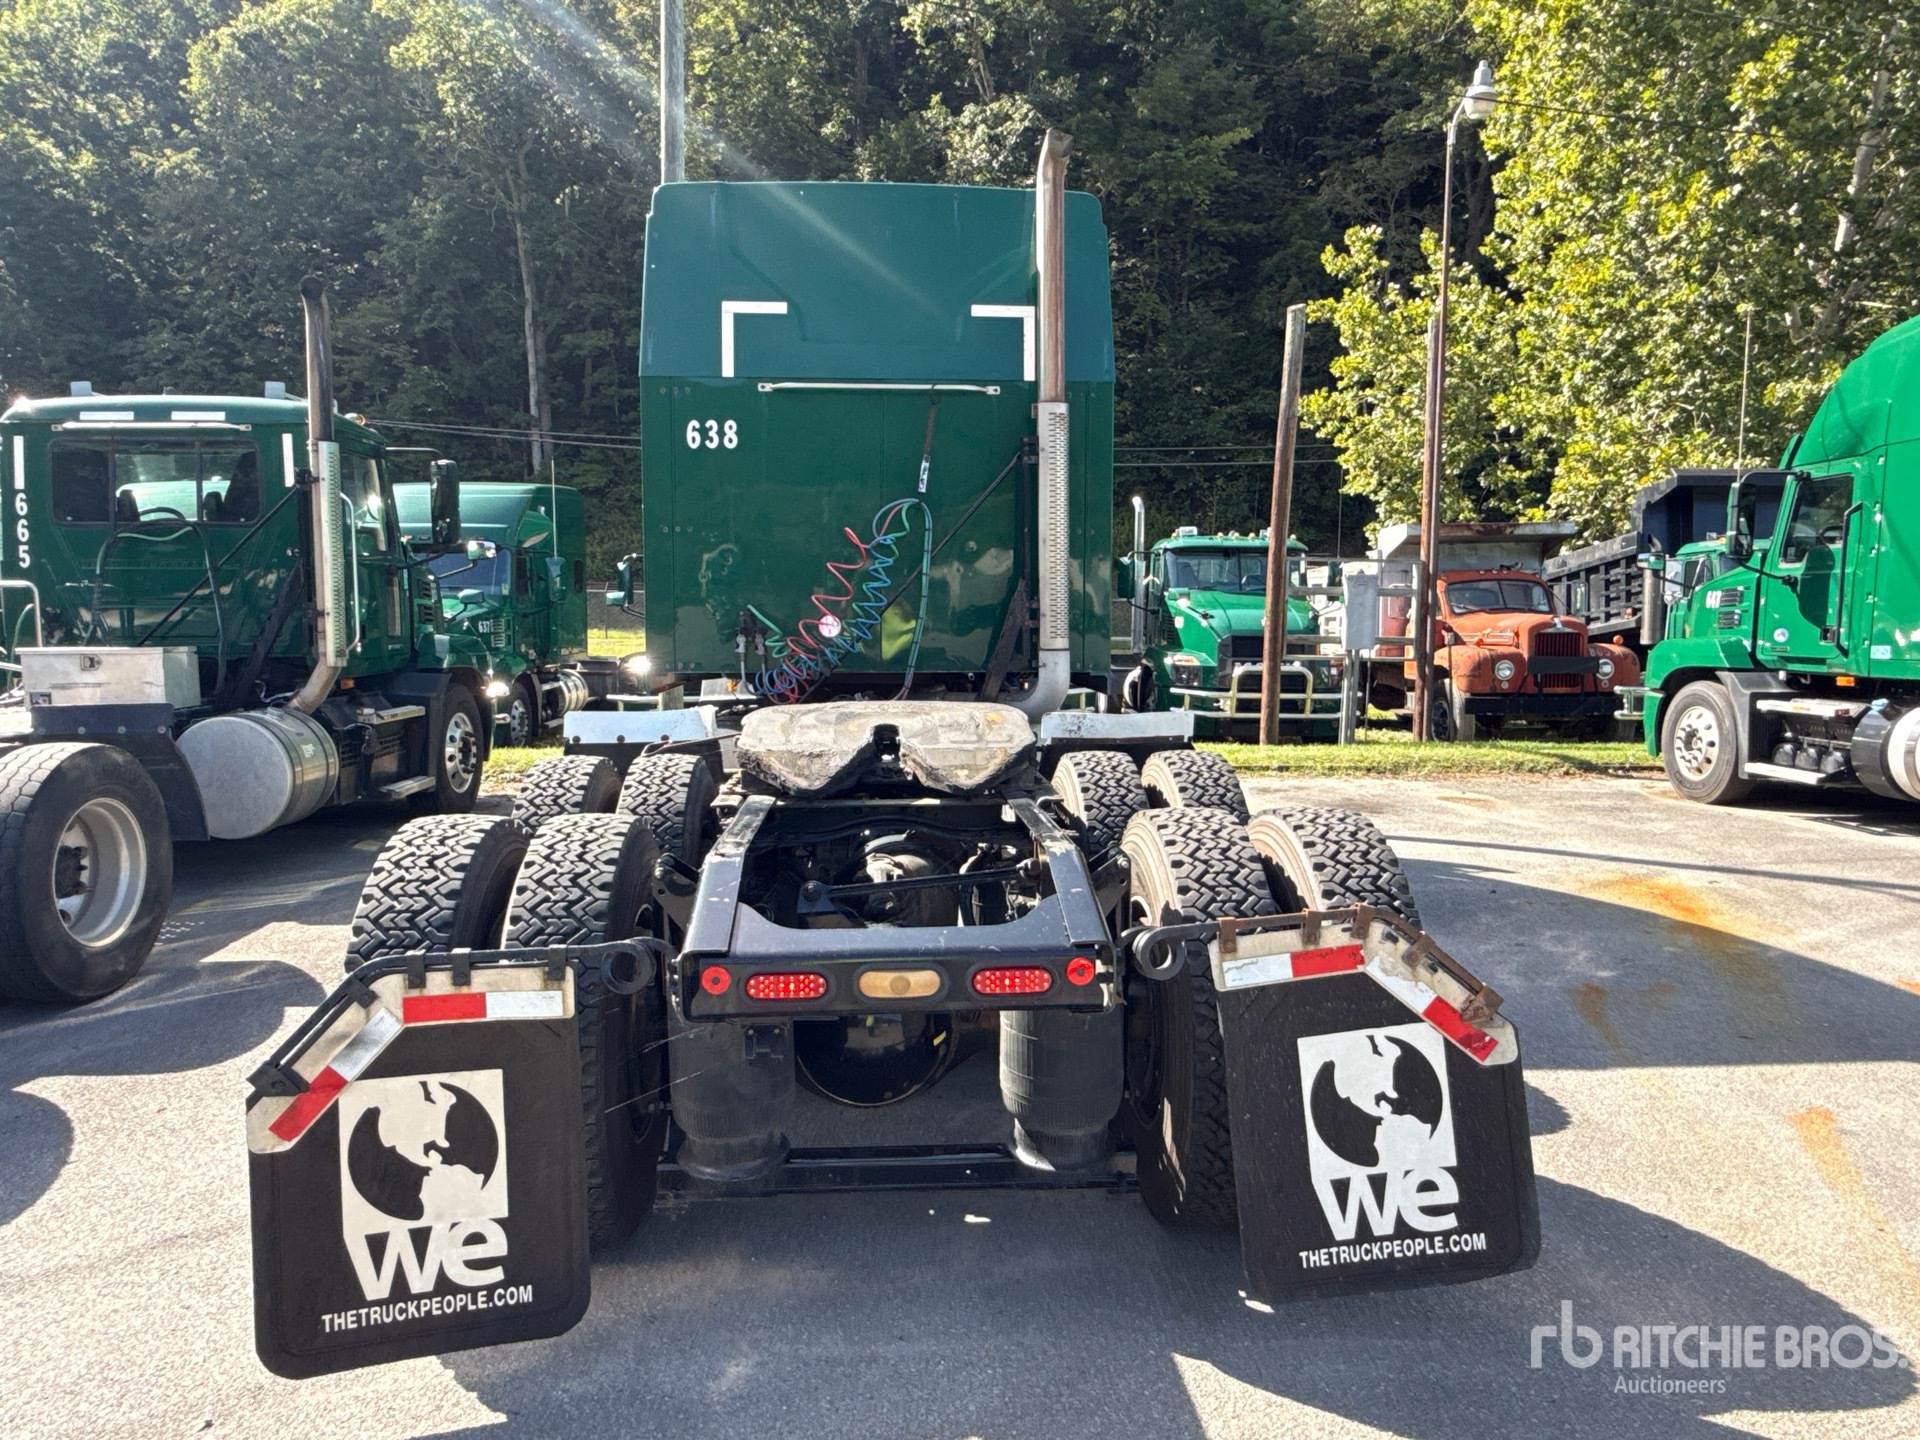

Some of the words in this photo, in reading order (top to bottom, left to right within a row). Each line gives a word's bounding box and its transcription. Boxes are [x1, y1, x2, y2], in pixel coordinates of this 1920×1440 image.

[686, 419, 738, 449] 638
[15, 492, 31, 568] 665
[1299, 1232, 1487, 1269] THETRUCKPEOPLE.COM
[321, 1284, 533, 1333] THETRUCKPEOPLE.COM
